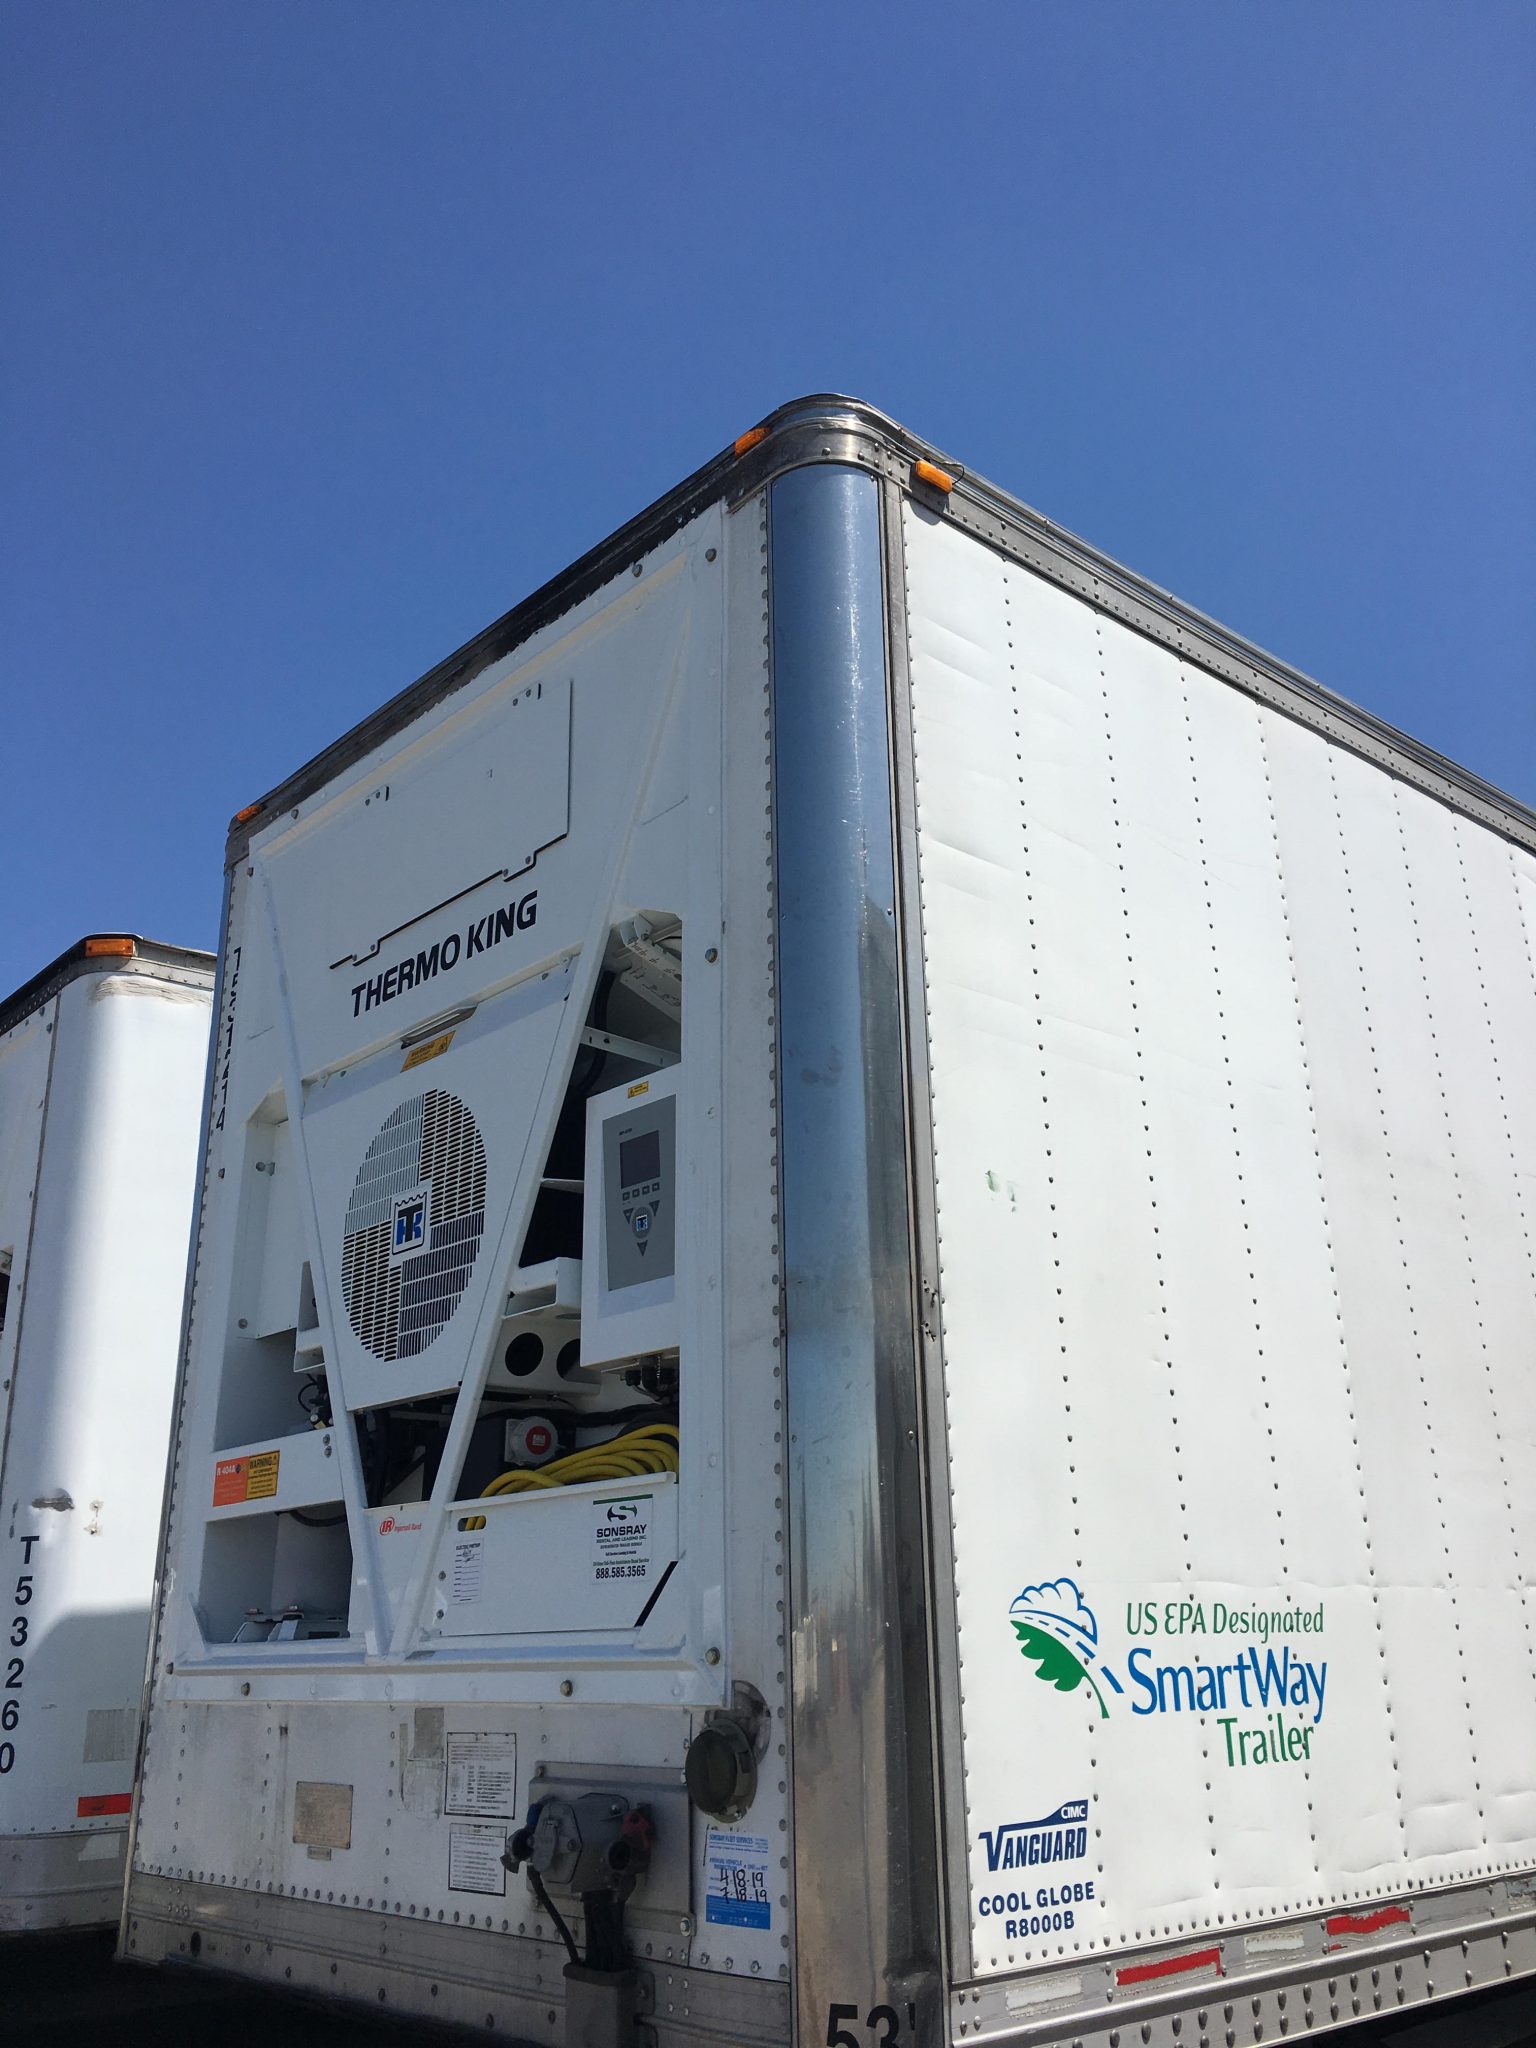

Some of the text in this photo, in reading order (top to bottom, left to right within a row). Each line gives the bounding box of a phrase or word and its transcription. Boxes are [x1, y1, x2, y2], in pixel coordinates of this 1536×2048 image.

[352, 890, 538, 1017] THERMO KING
[596, 1524, 647, 1538] SONSRAY
[596, 1565, 646, 1579] 888.585.3565
[1126, 1602, 1324, 1644] US EPA Designated
[1127, 1646, 1328, 1723] SmartWay
[1217, 1713, 1314, 1767] Trailer
[1060, 1804, 1086, 1820] CIMC
[978, 1826, 1087, 1872] VANGUARD
[978, 1881, 1095, 1916] COOL GLOBE
[1005, 1910, 1075, 1939] R8000B
